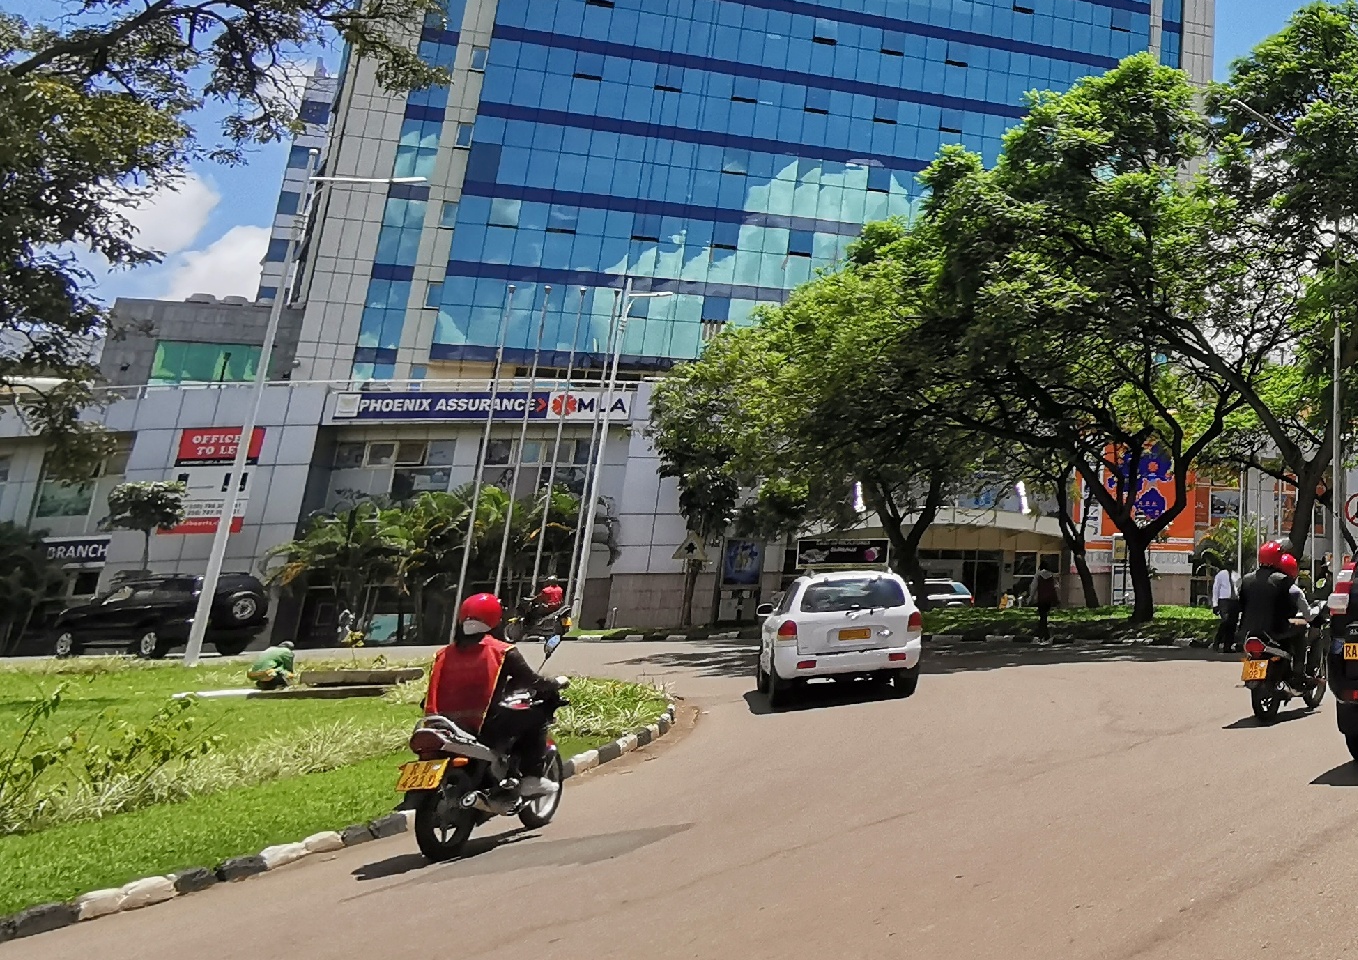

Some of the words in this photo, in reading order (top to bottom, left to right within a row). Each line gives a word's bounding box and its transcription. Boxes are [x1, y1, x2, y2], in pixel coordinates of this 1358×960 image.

[359, 399, 431, 413] PHOENIX
[434, 397, 536, 412] ASSURANCE
[577, 400, 627, 414] MA
[196, 445, 215, 456] TO
[219, 445, 239, 456] LE
[46, 544, 109, 560] BRANCH
